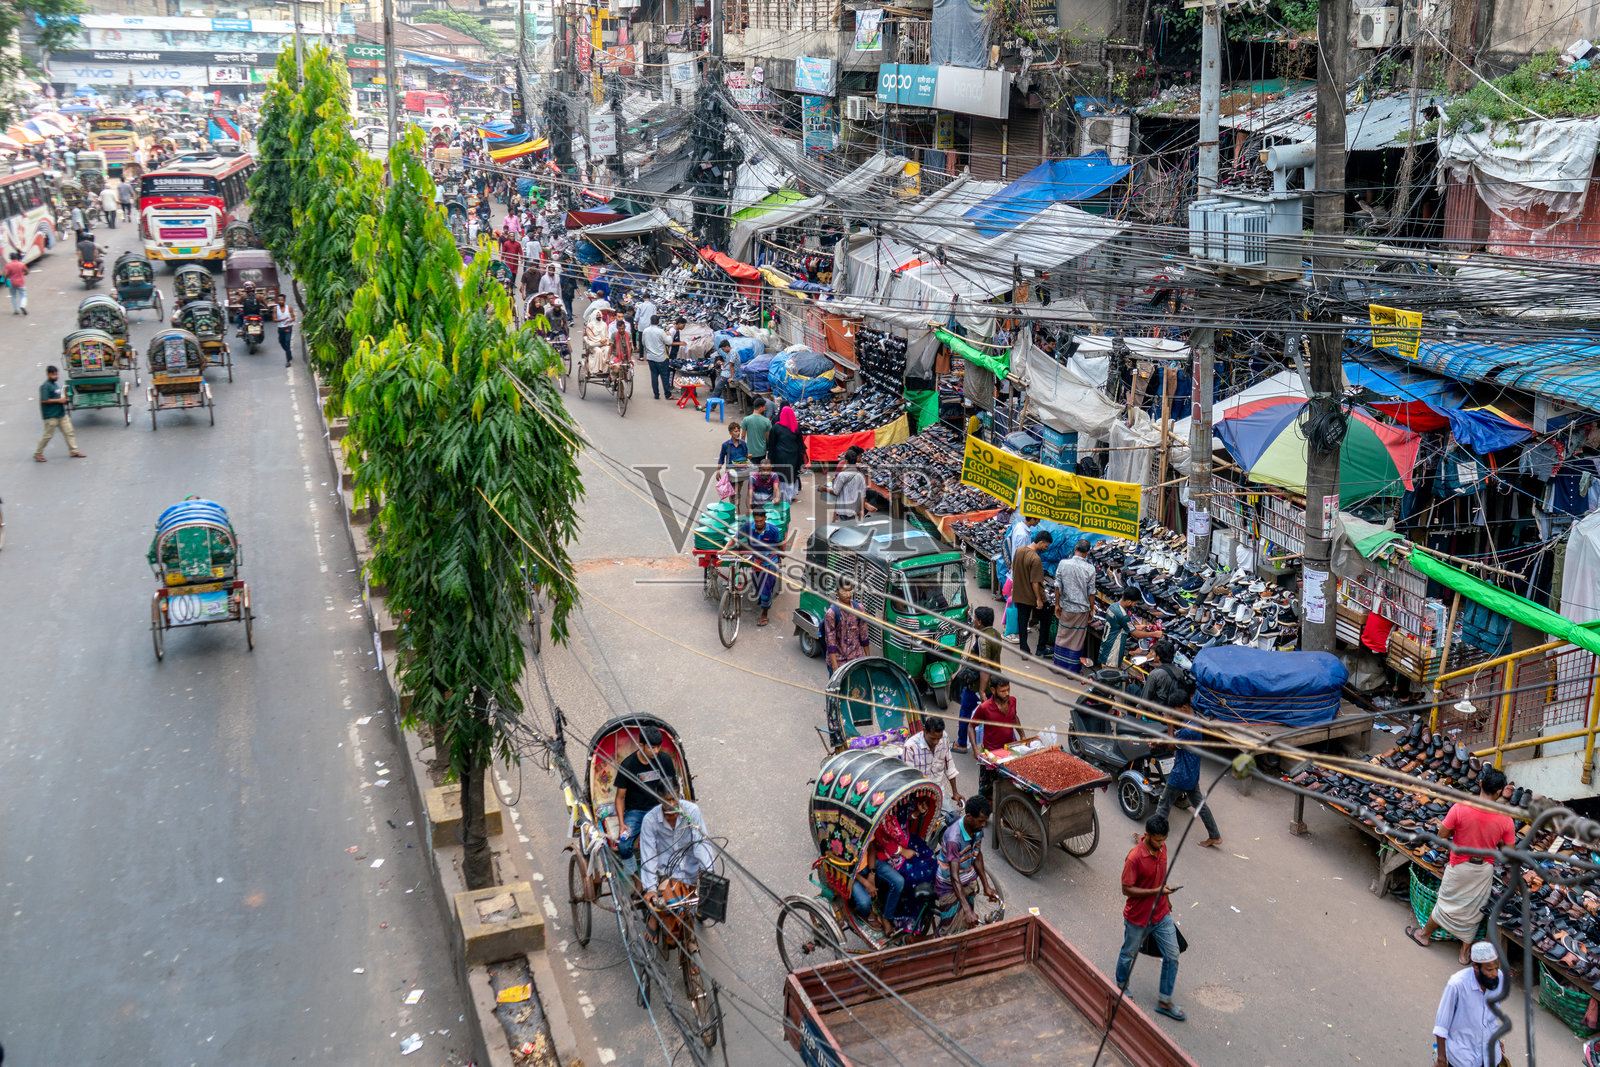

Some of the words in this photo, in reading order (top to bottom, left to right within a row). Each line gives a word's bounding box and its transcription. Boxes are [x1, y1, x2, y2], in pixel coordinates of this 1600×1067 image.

[353, 47, 386, 57] oppo
[73, 66, 114, 78] vivo
[139, 67, 181, 80] vivo
[882, 73, 912, 93] oppo
[967, 472, 987, 486] 01311
[988, 481, 1013, 499] 802085
[1029, 470, 1056, 489] ১০০
[1028, 488, 1055, 504] ১০০০
[1026, 503, 1050, 515] 09638
[1050, 511, 1079, 522] 557766
[1084, 516, 1105, 527] 01311
[1106, 520, 1136, 534] 802085
